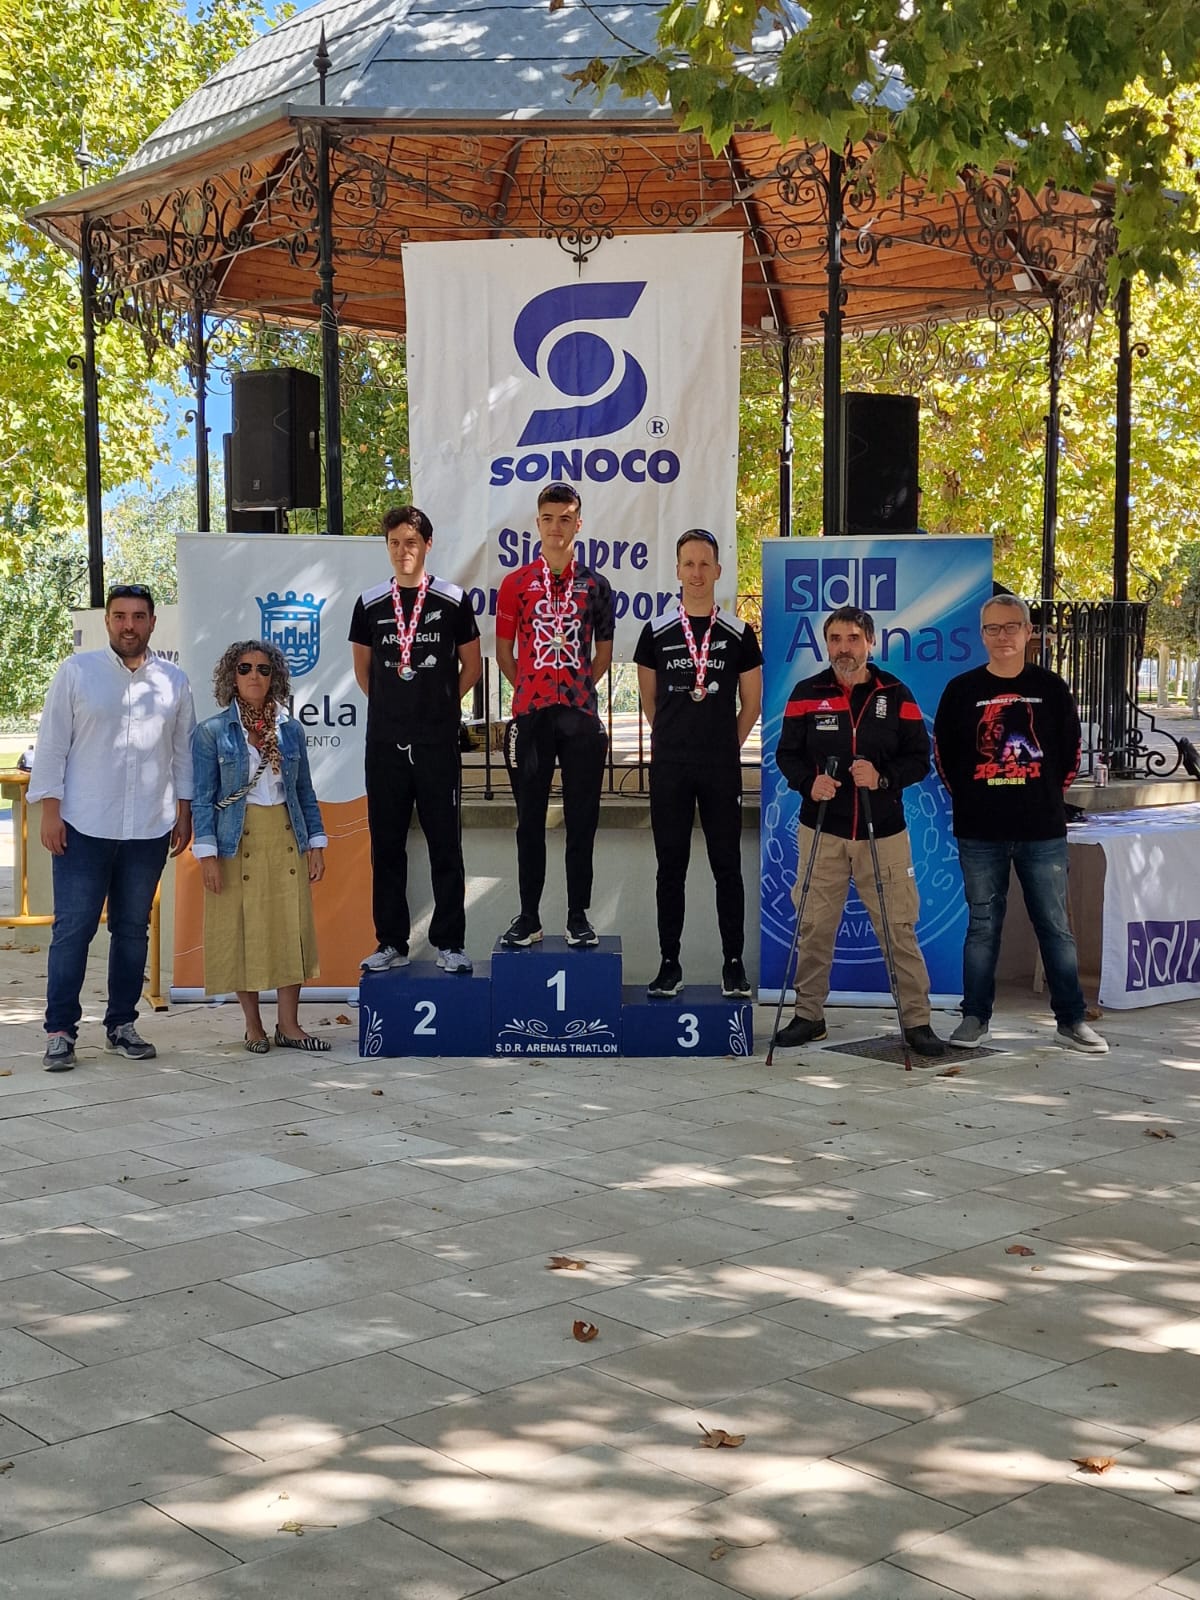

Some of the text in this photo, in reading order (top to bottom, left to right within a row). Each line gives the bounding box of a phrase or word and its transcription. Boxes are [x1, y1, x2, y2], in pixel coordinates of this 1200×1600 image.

[489, 448, 681, 486] SONOCO
[791, 559, 888, 610] sdr
[785, 616, 973, 664] Anas
[546, 970, 566, 1011] 1
[413, 1000, 437, 1035] 2
[677, 1013, 700, 1048] 3
[495, 1043, 618, 1053] S.D.R. ARENAS TRIATLON
